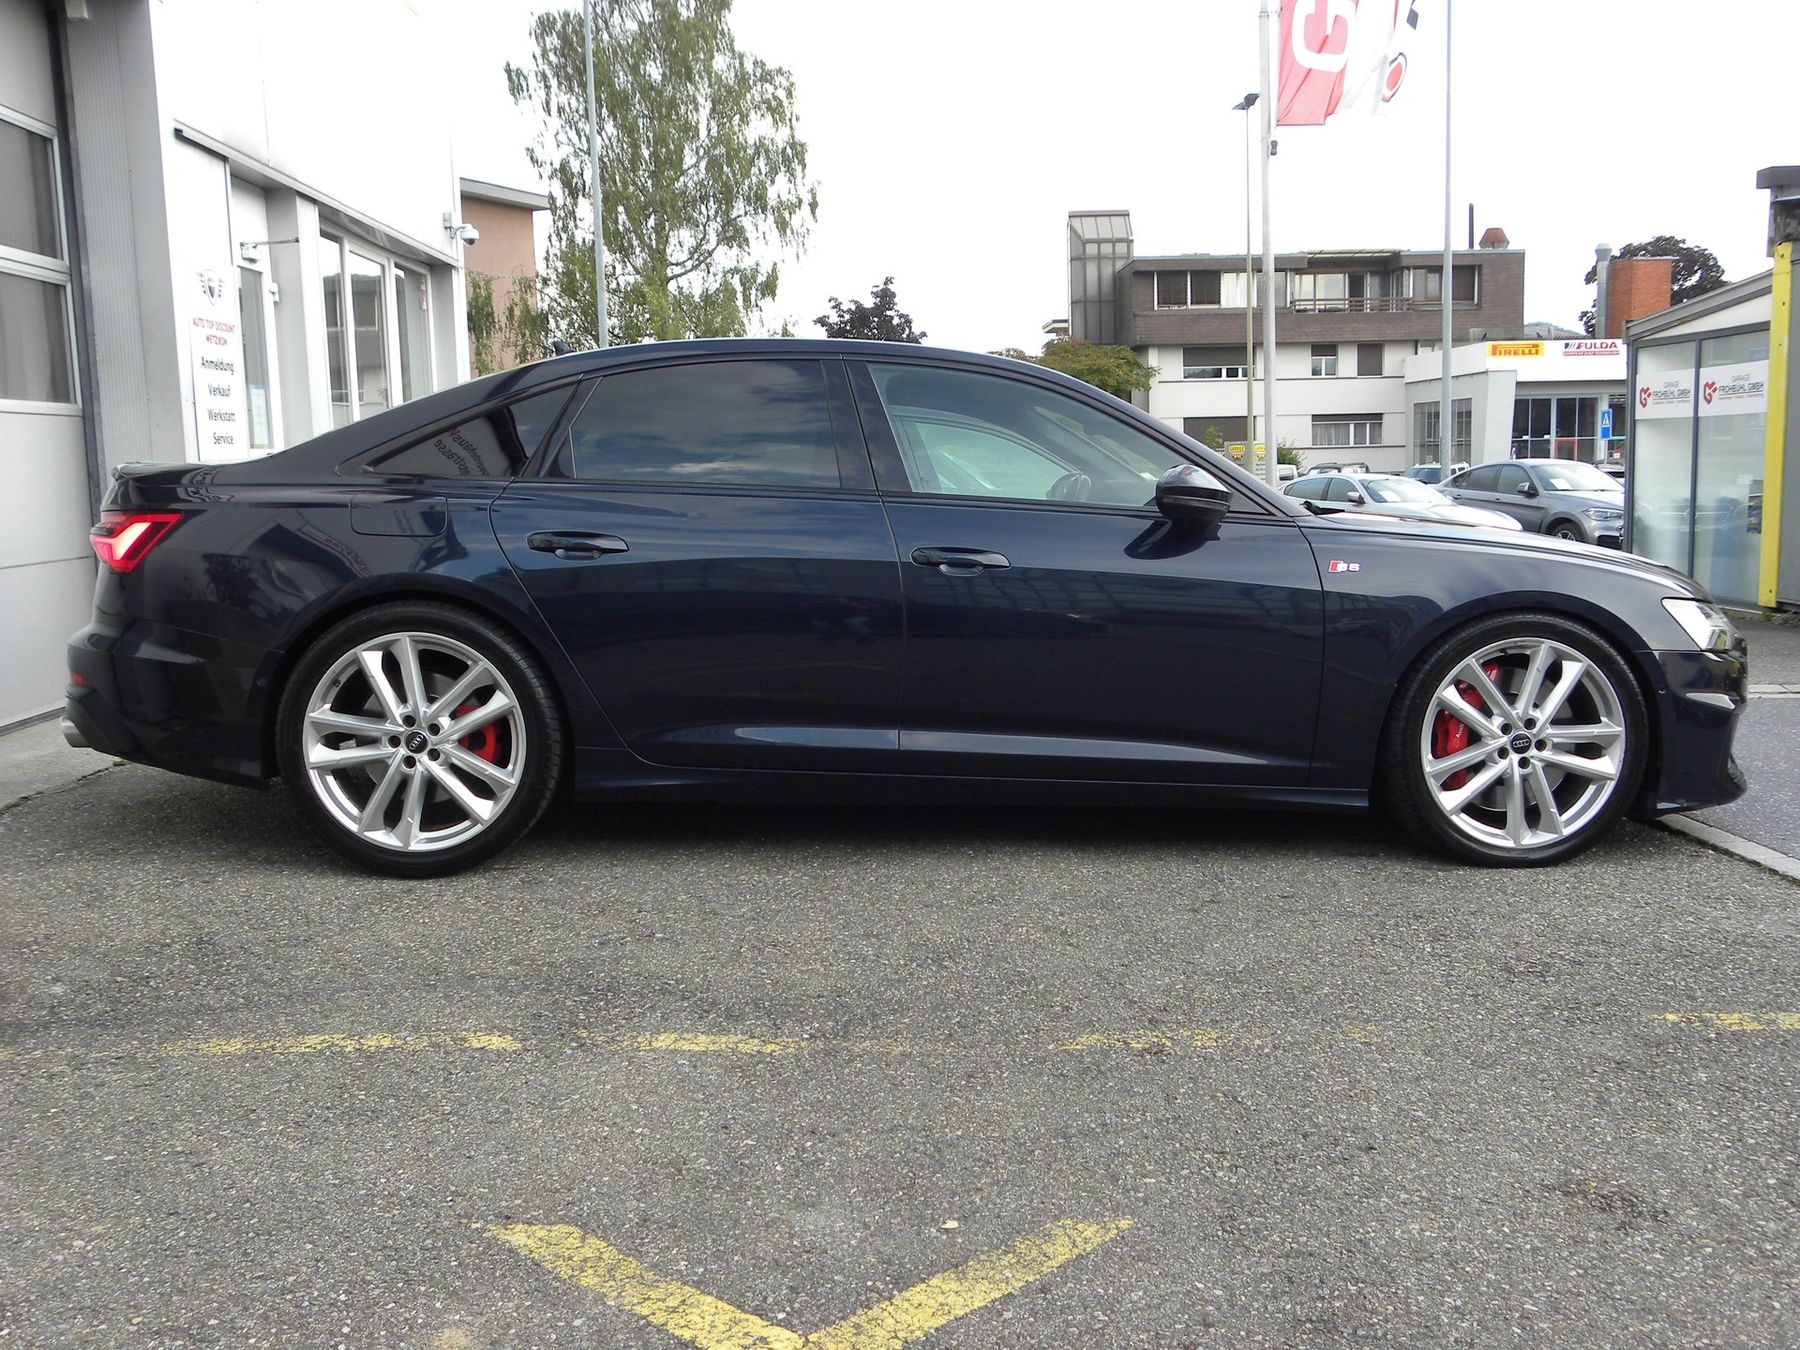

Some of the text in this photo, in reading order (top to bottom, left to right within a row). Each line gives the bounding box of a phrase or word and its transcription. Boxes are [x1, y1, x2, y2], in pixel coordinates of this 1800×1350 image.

[192, 316, 236, 333] AUTO TOP DISCOUNT
[1491, 344, 1540, 356] PIRELLI
[1576, 341, 1618, 350] FULDA
[201, 356, 235, 376] Anmeldung
[208, 383, 231, 397] Verkauf
[207, 408, 236, 423] Werkstatt
[213, 432, 234, 445] Service
